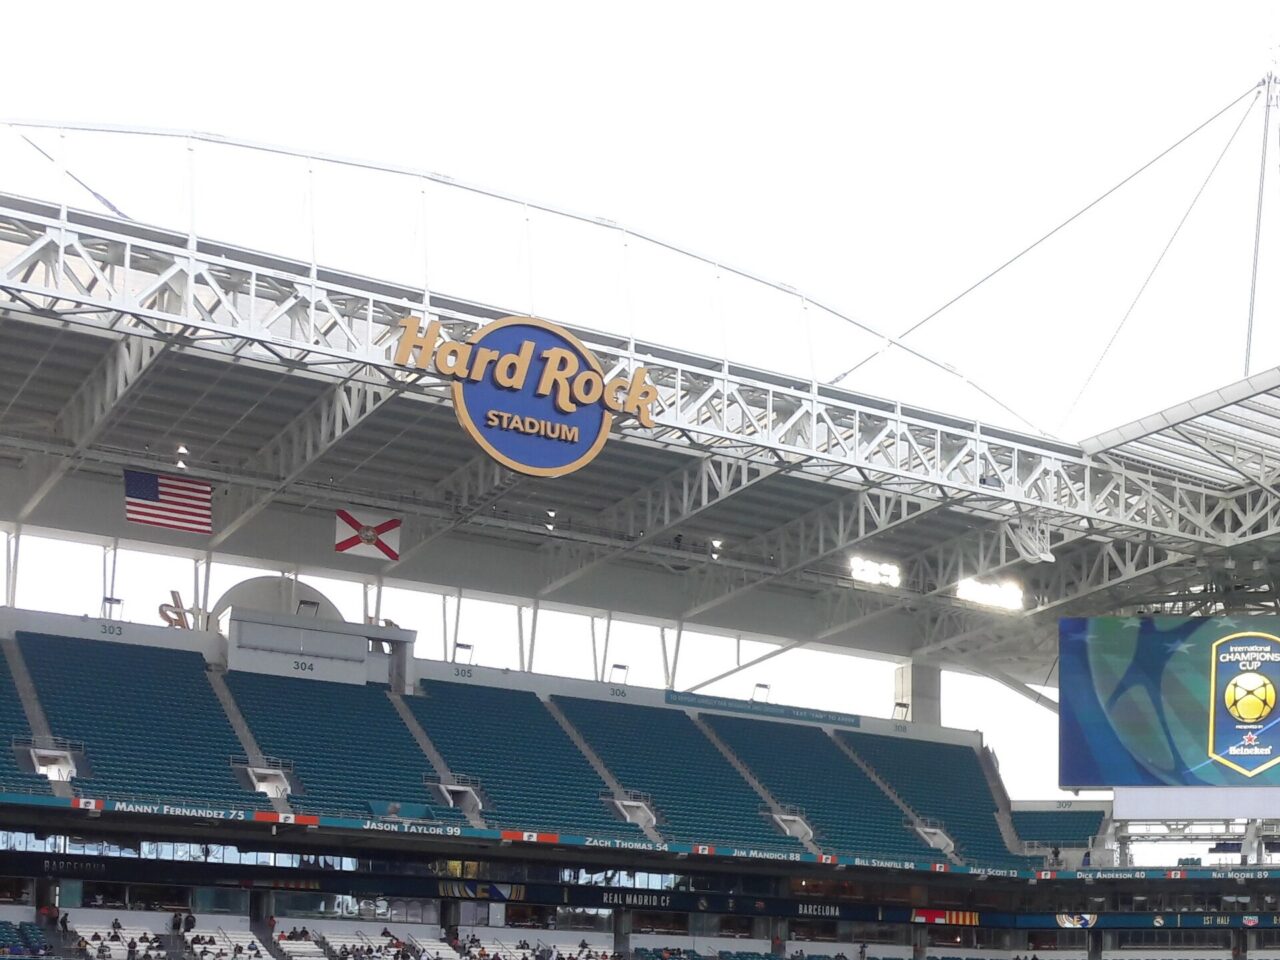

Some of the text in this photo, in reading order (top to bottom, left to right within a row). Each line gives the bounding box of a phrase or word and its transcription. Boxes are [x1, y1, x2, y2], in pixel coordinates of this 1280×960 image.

[394, 315, 659, 428] Hard Rock
[485, 408, 579, 442] STADIUM
[101, 625, 123, 636] 303
[1219, 652, 1280, 663] CHAMPIONS
[293, 661, 315, 672] 304
[1239, 661, 1261, 671] CUP
[454, 668, 473, 678] 305
[609, 688, 627, 698] 306
[115, 801, 245, 820] MANNY FERNANDEZ 75
[363, 820, 461, 836] JASON TAYLOR 99
[585, 837, 668, 852] ZACH THOMAS 54
[733, 849, 801, 861] JIM MANDICH 88
[855, 858, 868, 866] BILL
[904, 861, 915, 870] 84
[1077, 871, 1146, 879] DICK ANDERSON 40
[1212, 871, 1225, 879] NAT
[1257, 871, 1269, 879] 89
[603, 892, 670, 907] REAL MADRID CF
[798, 903, 840, 917] BARCELONA
[1216, 916, 1230, 925] HALF
